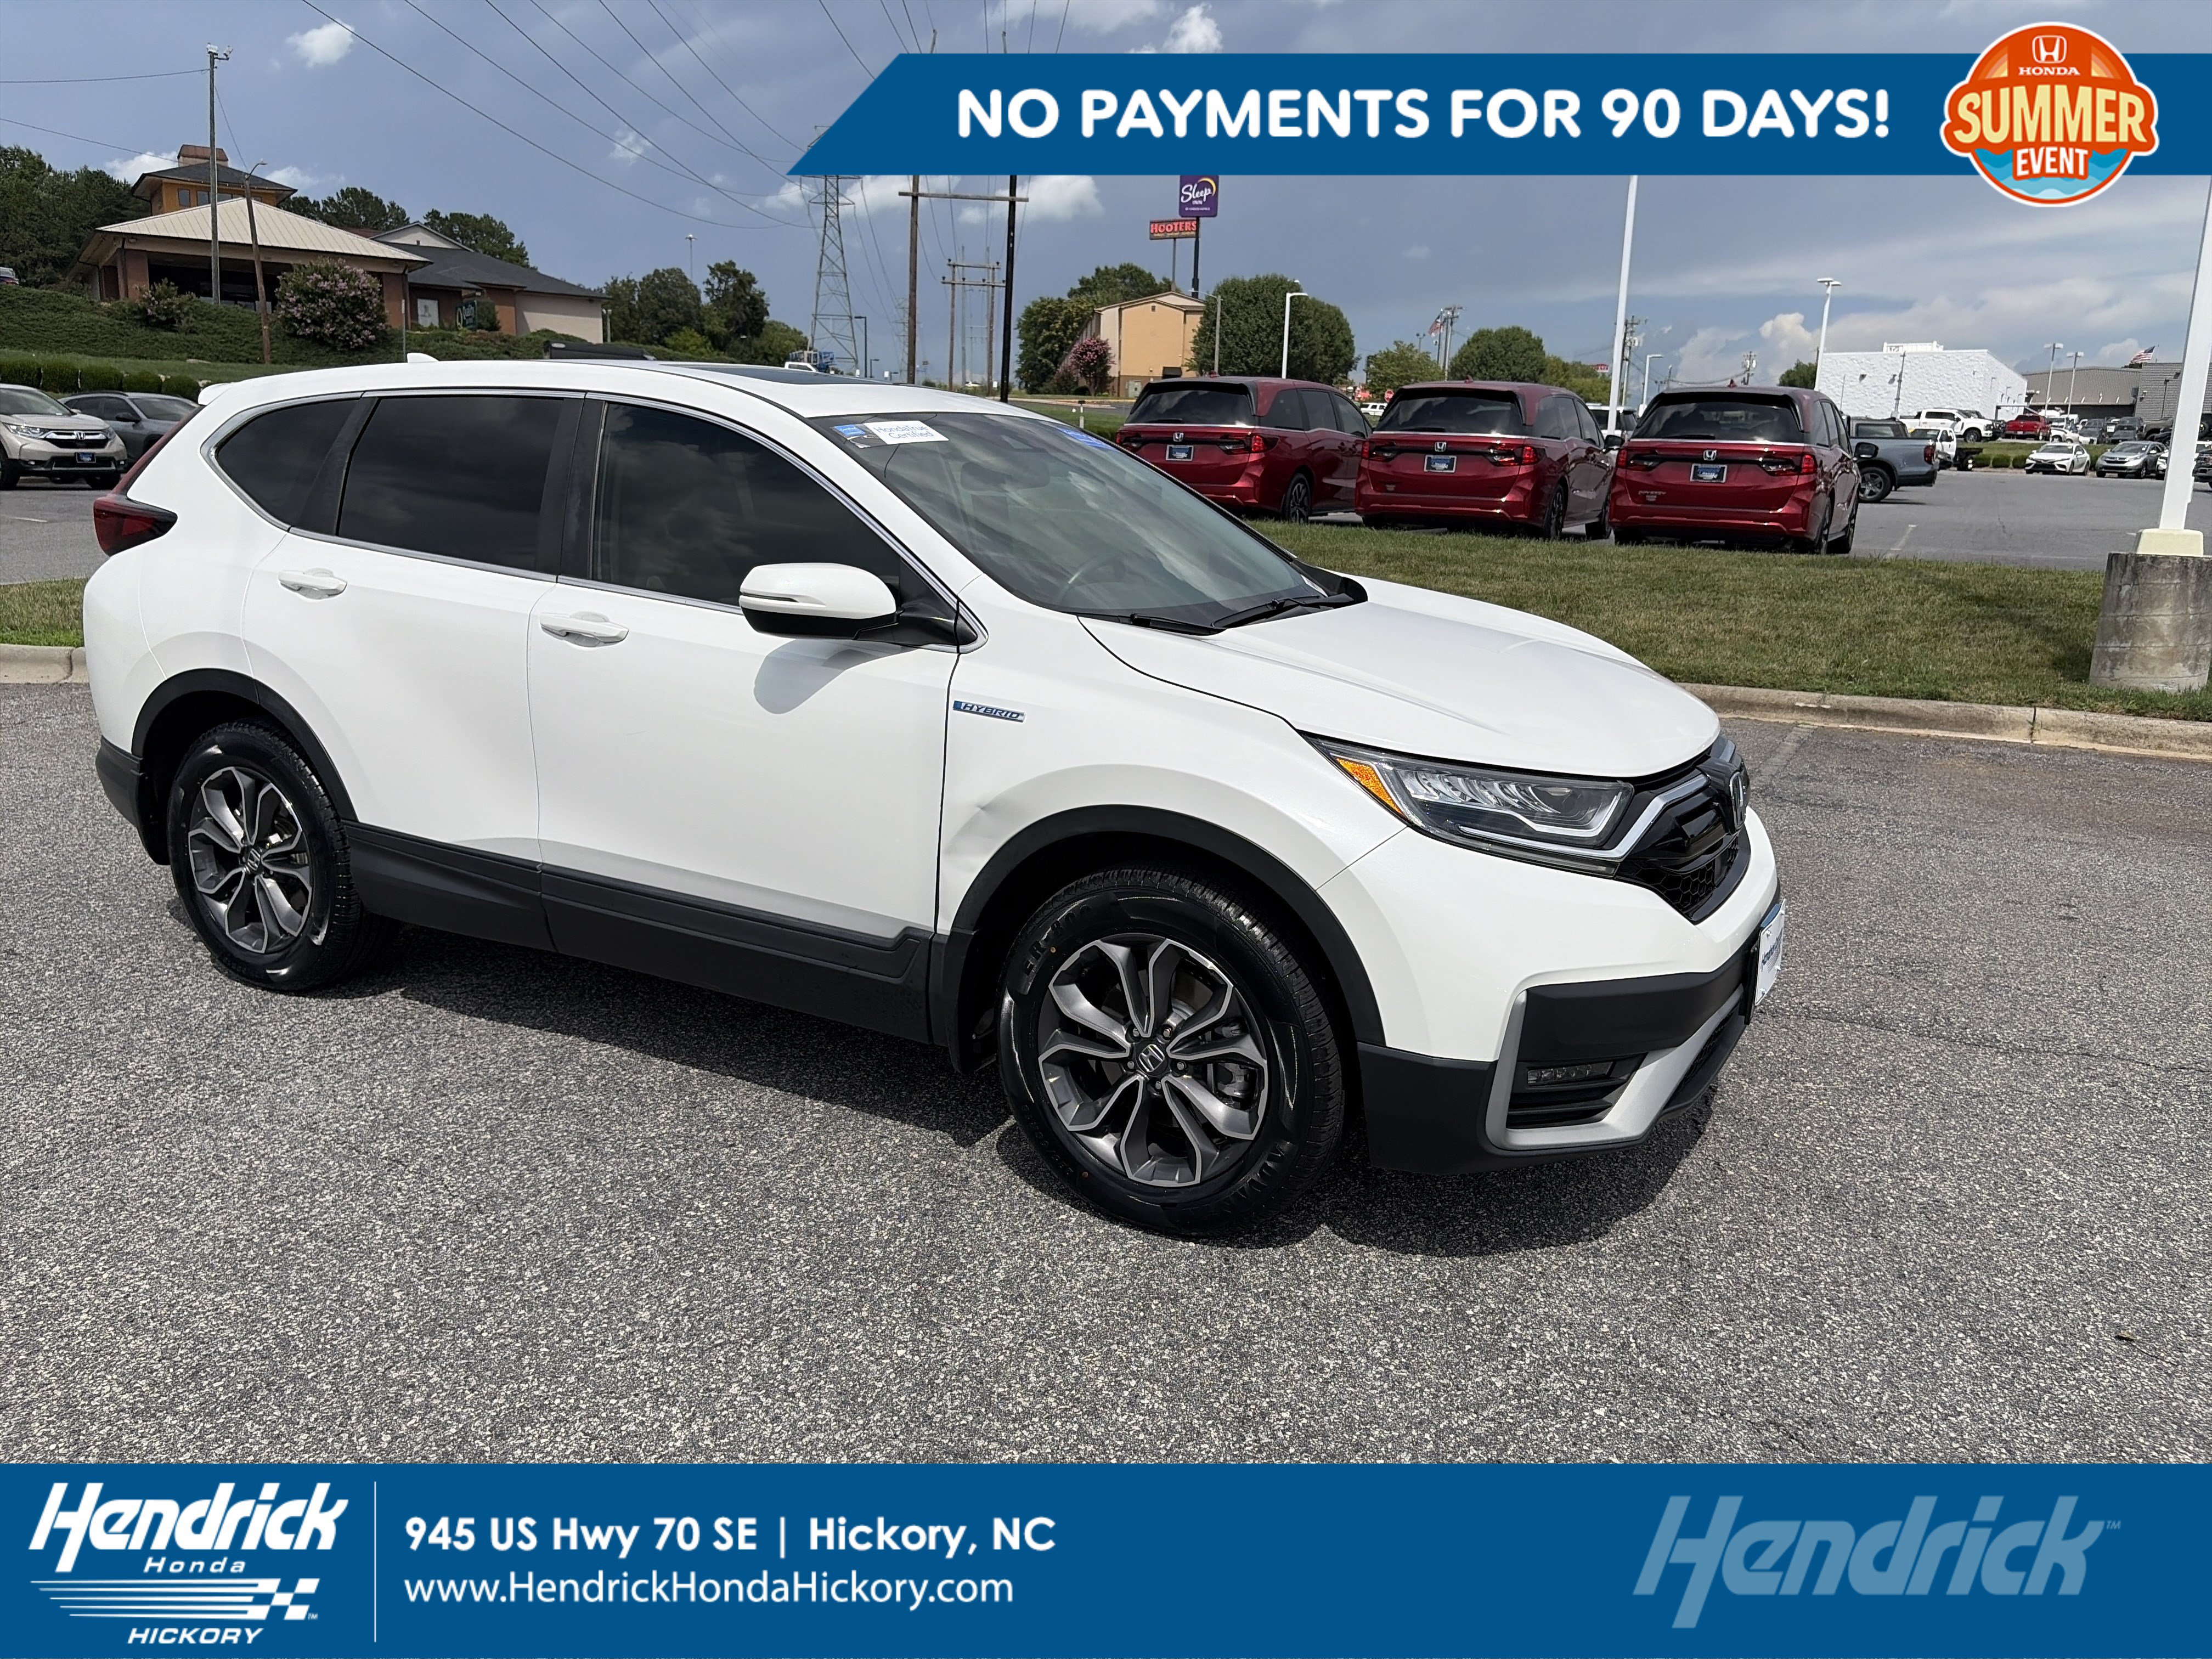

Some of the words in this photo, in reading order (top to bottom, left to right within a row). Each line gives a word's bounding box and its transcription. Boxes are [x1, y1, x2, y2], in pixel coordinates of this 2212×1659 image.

[1181, 183, 1212, 203] Sleep
[1150, 221, 1197, 233] HOOTERS
[889, 431, 934, 439] Certified
[963, 703, 1020, 719] HYBRID
